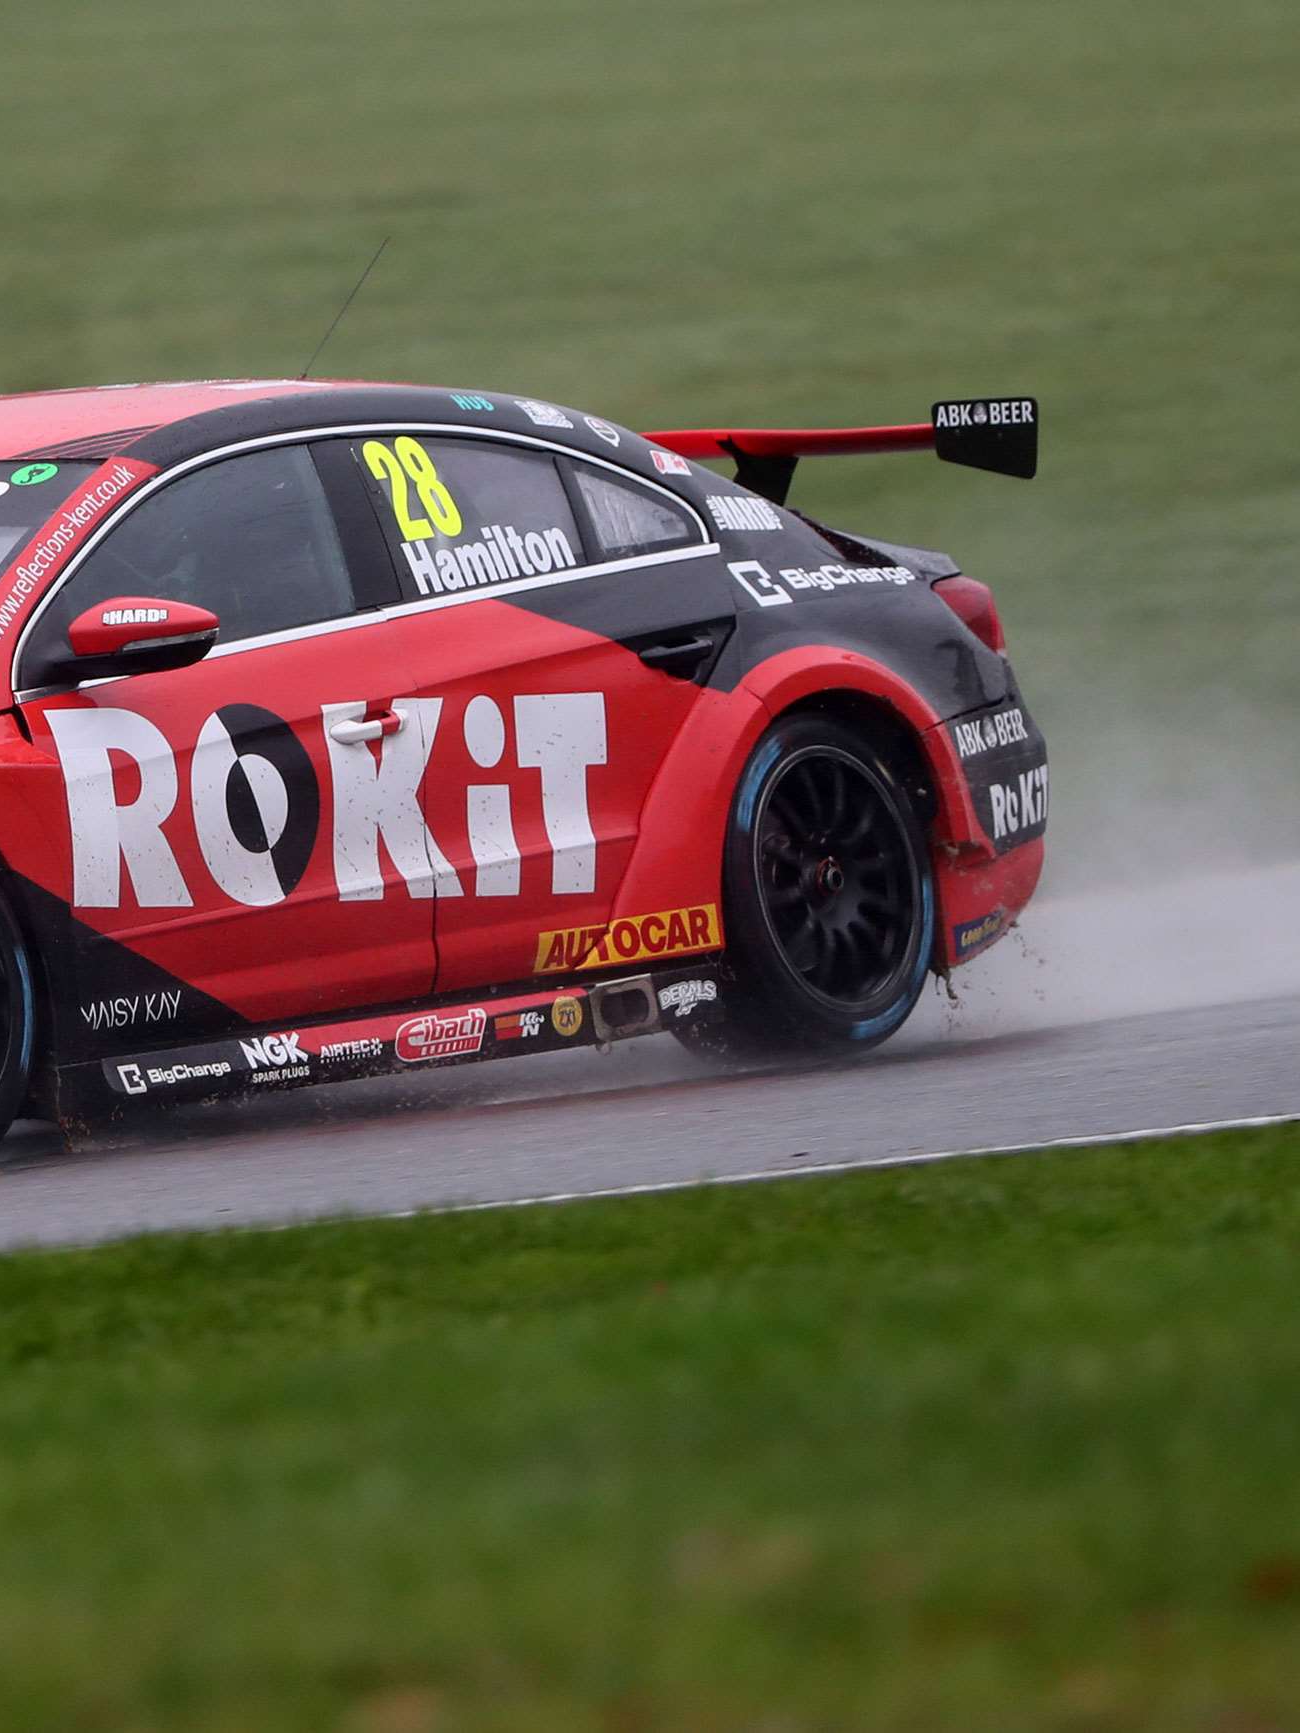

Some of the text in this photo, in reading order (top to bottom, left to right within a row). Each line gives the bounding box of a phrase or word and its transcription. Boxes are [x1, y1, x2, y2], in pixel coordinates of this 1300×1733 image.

[936, 401, 1034, 428] ABK BEER
[362, 436, 463, 542] 28
[400, 525, 577, 595] Hamilton
[779, 565, 916, 590] BigChange
[109, 609, 161, 625] HARD
[954, 708, 1029, 758] ABK BEER
[542, 908, 712, 970] AUTOCAR
[81, 990, 181, 1031] MAISY KAY
[657, 979, 717, 1010] DECALS
[239, 1032, 309, 1069] NGK
[320, 1040, 371, 1058] AIRTEC
[397, 1010, 486, 1060] Eibach
[147, 1061, 232, 1084] BigChange
[252, 1066, 310, 1084] SPARK PLUGS
